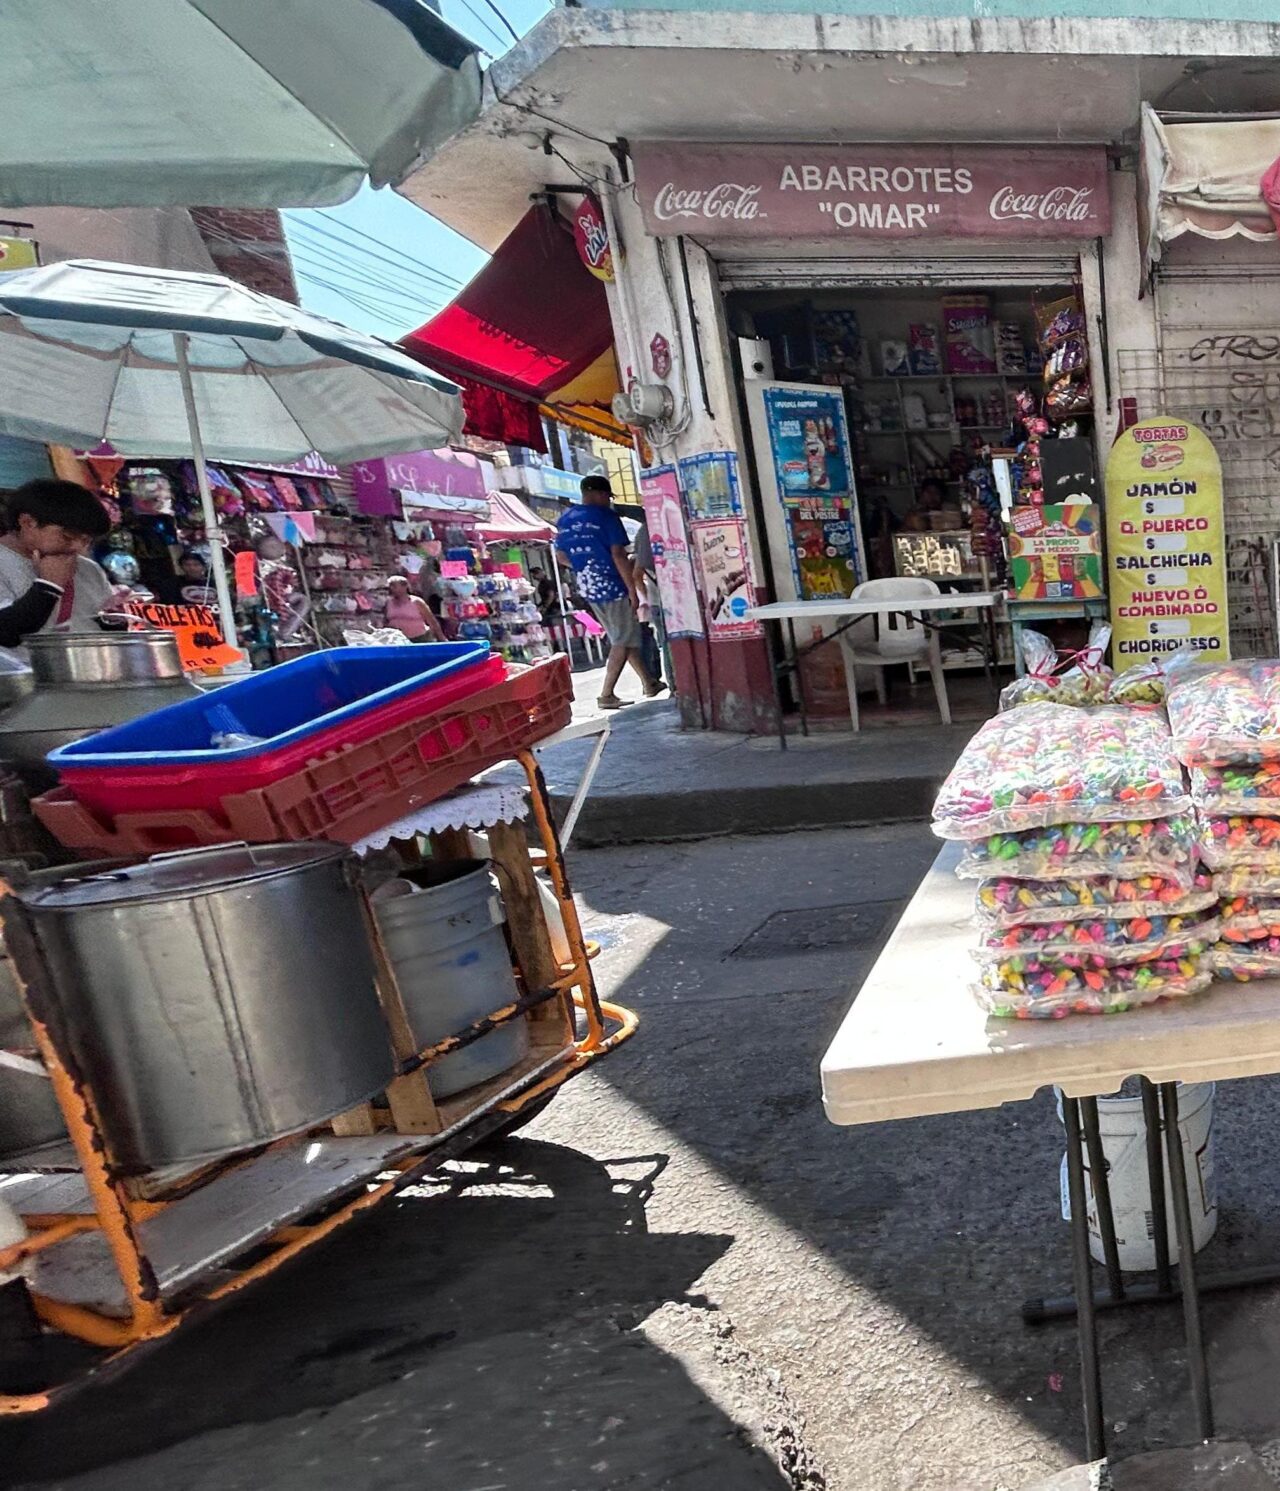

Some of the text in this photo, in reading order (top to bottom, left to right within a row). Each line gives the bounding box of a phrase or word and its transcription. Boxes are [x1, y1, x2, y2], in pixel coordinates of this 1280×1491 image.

[780, 165, 973, 193] ABARROTES
[818, 201, 940, 229] "OMAR"
[1134, 427, 1187, 442] TORTAS
[1126, 477, 1197, 498] JAMÓN
[1143, 518, 1208, 533] PUERCO
[1131, 589, 1190, 604] HUEVO
